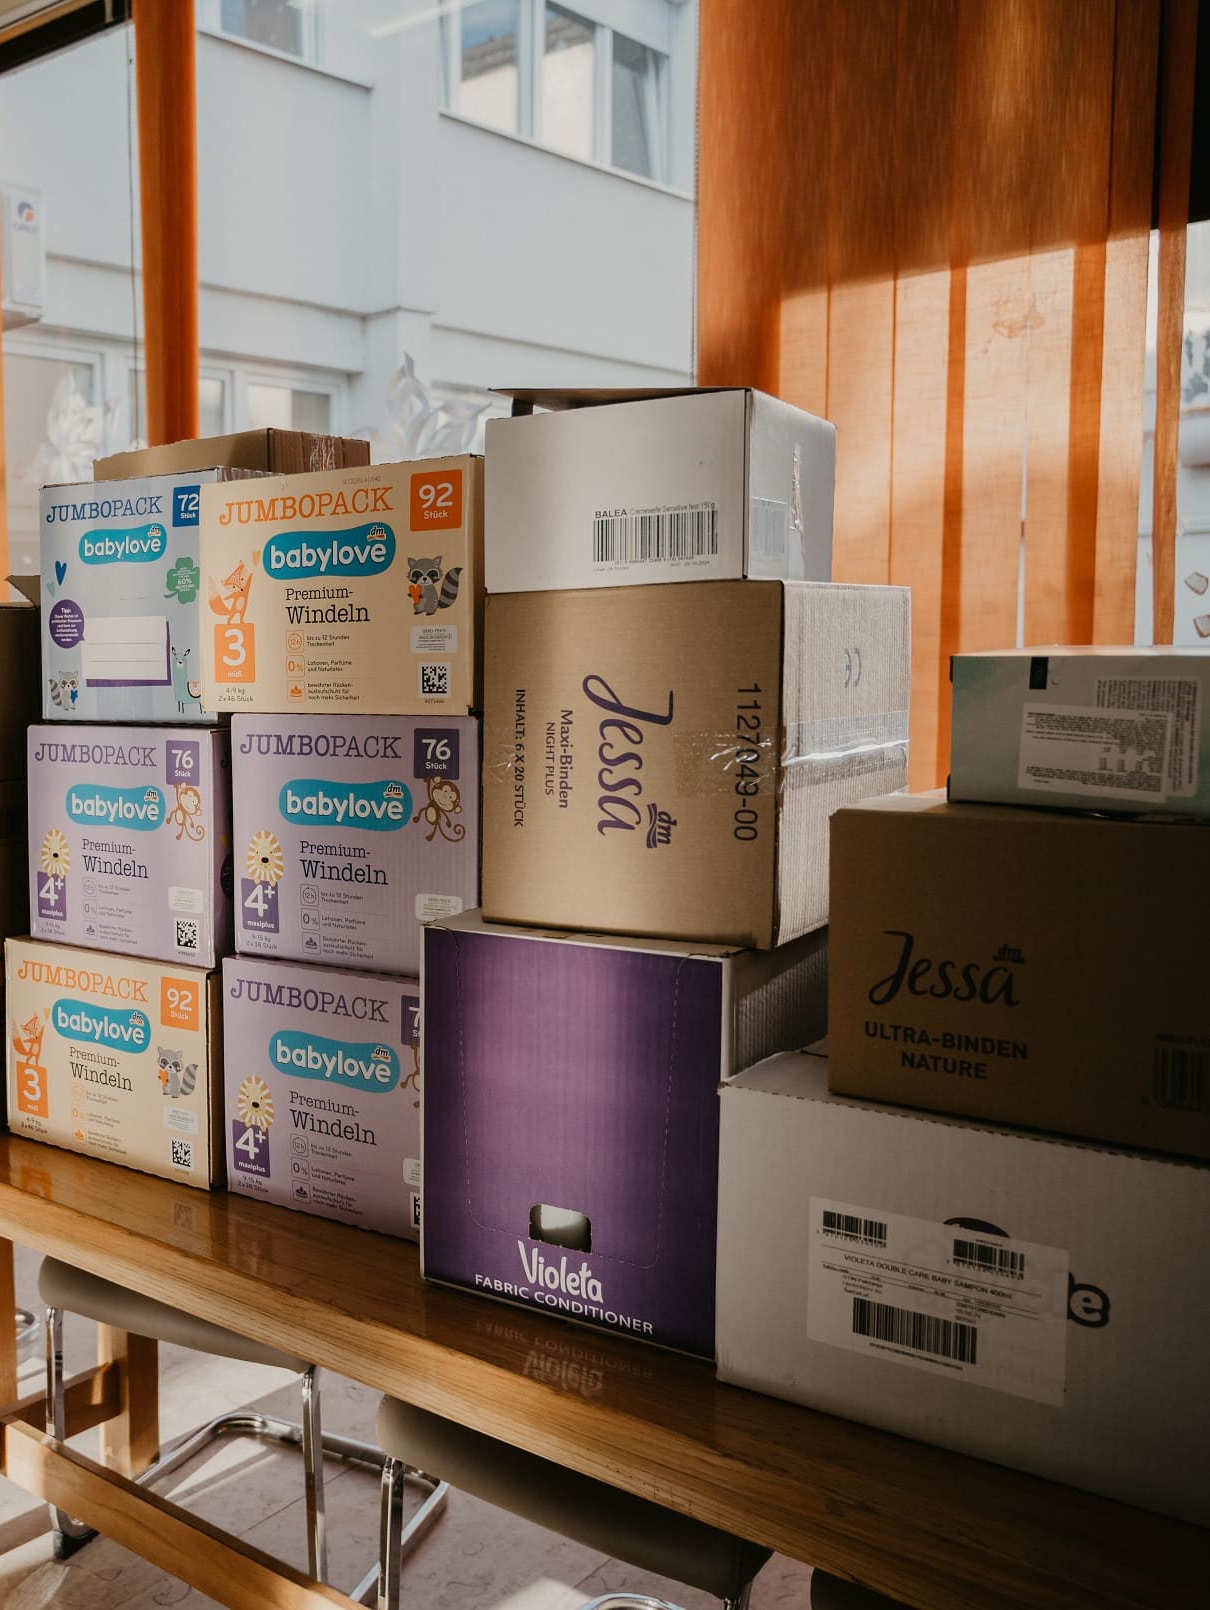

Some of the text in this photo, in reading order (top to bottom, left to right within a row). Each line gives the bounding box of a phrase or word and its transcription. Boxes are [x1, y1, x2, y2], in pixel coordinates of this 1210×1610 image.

[177, 493, 199, 512] 72
[219, 486, 394, 526] JUMBOPACK
[419, 482, 453, 509] 92
[46, 496, 163, 523] JUMBOPACK
[180, 512, 196, 520] Stück
[424, 510, 448, 519] Stück
[595, 508, 628, 519] BALEA
[370, 526, 385, 536] dm
[84, 535, 161, 559] babylove
[270, 541, 386, 572] babylove
[285, 587, 353, 601] Premium-
[286, 604, 371, 625] Windeln
[223, 629, 246, 667] 3
[34, 743, 157, 767] JUMBOPACK
[171, 749, 194, 769] 76
[240, 734, 402, 759] JUMBOPACK
[421, 738, 451, 760] 76
[514, 689, 526, 828] INHALT: 6 X 20 STÜCK
[545, 722, 555, 795] NIGHT PLUS
[559, 709, 574, 809] Maxi-Binden
[582, 674, 673, 836] Jessa
[174, 769, 191, 777] Stück
[425, 762, 447, 770] Stück
[387, 783, 401, 792] dm
[71, 793, 159, 822] babylove
[286, 790, 404, 822] babylove
[657, 810, 677, 845] dm
[82, 838, 136, 855] Premium-
[300, 840, 370, 858] Premium-
[82, 855, 149, 879] Windeln
[300, 859, 389, 886] Windeln
[39, 877, 64, 907] 4+
[244, 884, 275, 918] 4+
[246, 920, 275, 929] maxiplus
[17, 960, 149, 1003] JUMBOPACK
[868, 930, 1021, 1007] Jessa
[166, 988, 192, 1012] 92
[230, 979, 389, 1023] JUMBOPACK
[58, 1007, 144, 1044] babylove
[170, 1010, 189, 1021] Stück
[409, 1006, 420, 1027] 7
[376, 1046, 388, 1056] dm
[865, 1020, 1028, 1059] ULTRA-BINDEN
[69, 1046, 120, 1067] Premium-
[276, 1040, 391, 1083] babylove
[901, 1050, 988, 1081] NATURE
[23, 1069, 41, 1101] 3
[70, 1061, 133, 1092] Windeln
[27, 1103, 39, 1112] midi
[290, 1090, 360, 1117] Premium-
[290, 1109, 377, 1146] Windeln
[235, 1127, 266, 1160] 4+
[238, 1160, 266, 1173] maxiplus
[517, 1239, 604, 1303] Violeta
[844, 1254, 875, 1267] VIOLETA
[876, 1261, 907, 1275] DOUBLE
[909, 1268, 930, 1280] CARE
[931, 1273, 952, 1285] BABY
[475, 1273, 654, 1335] FABRIC CONDITIONER
